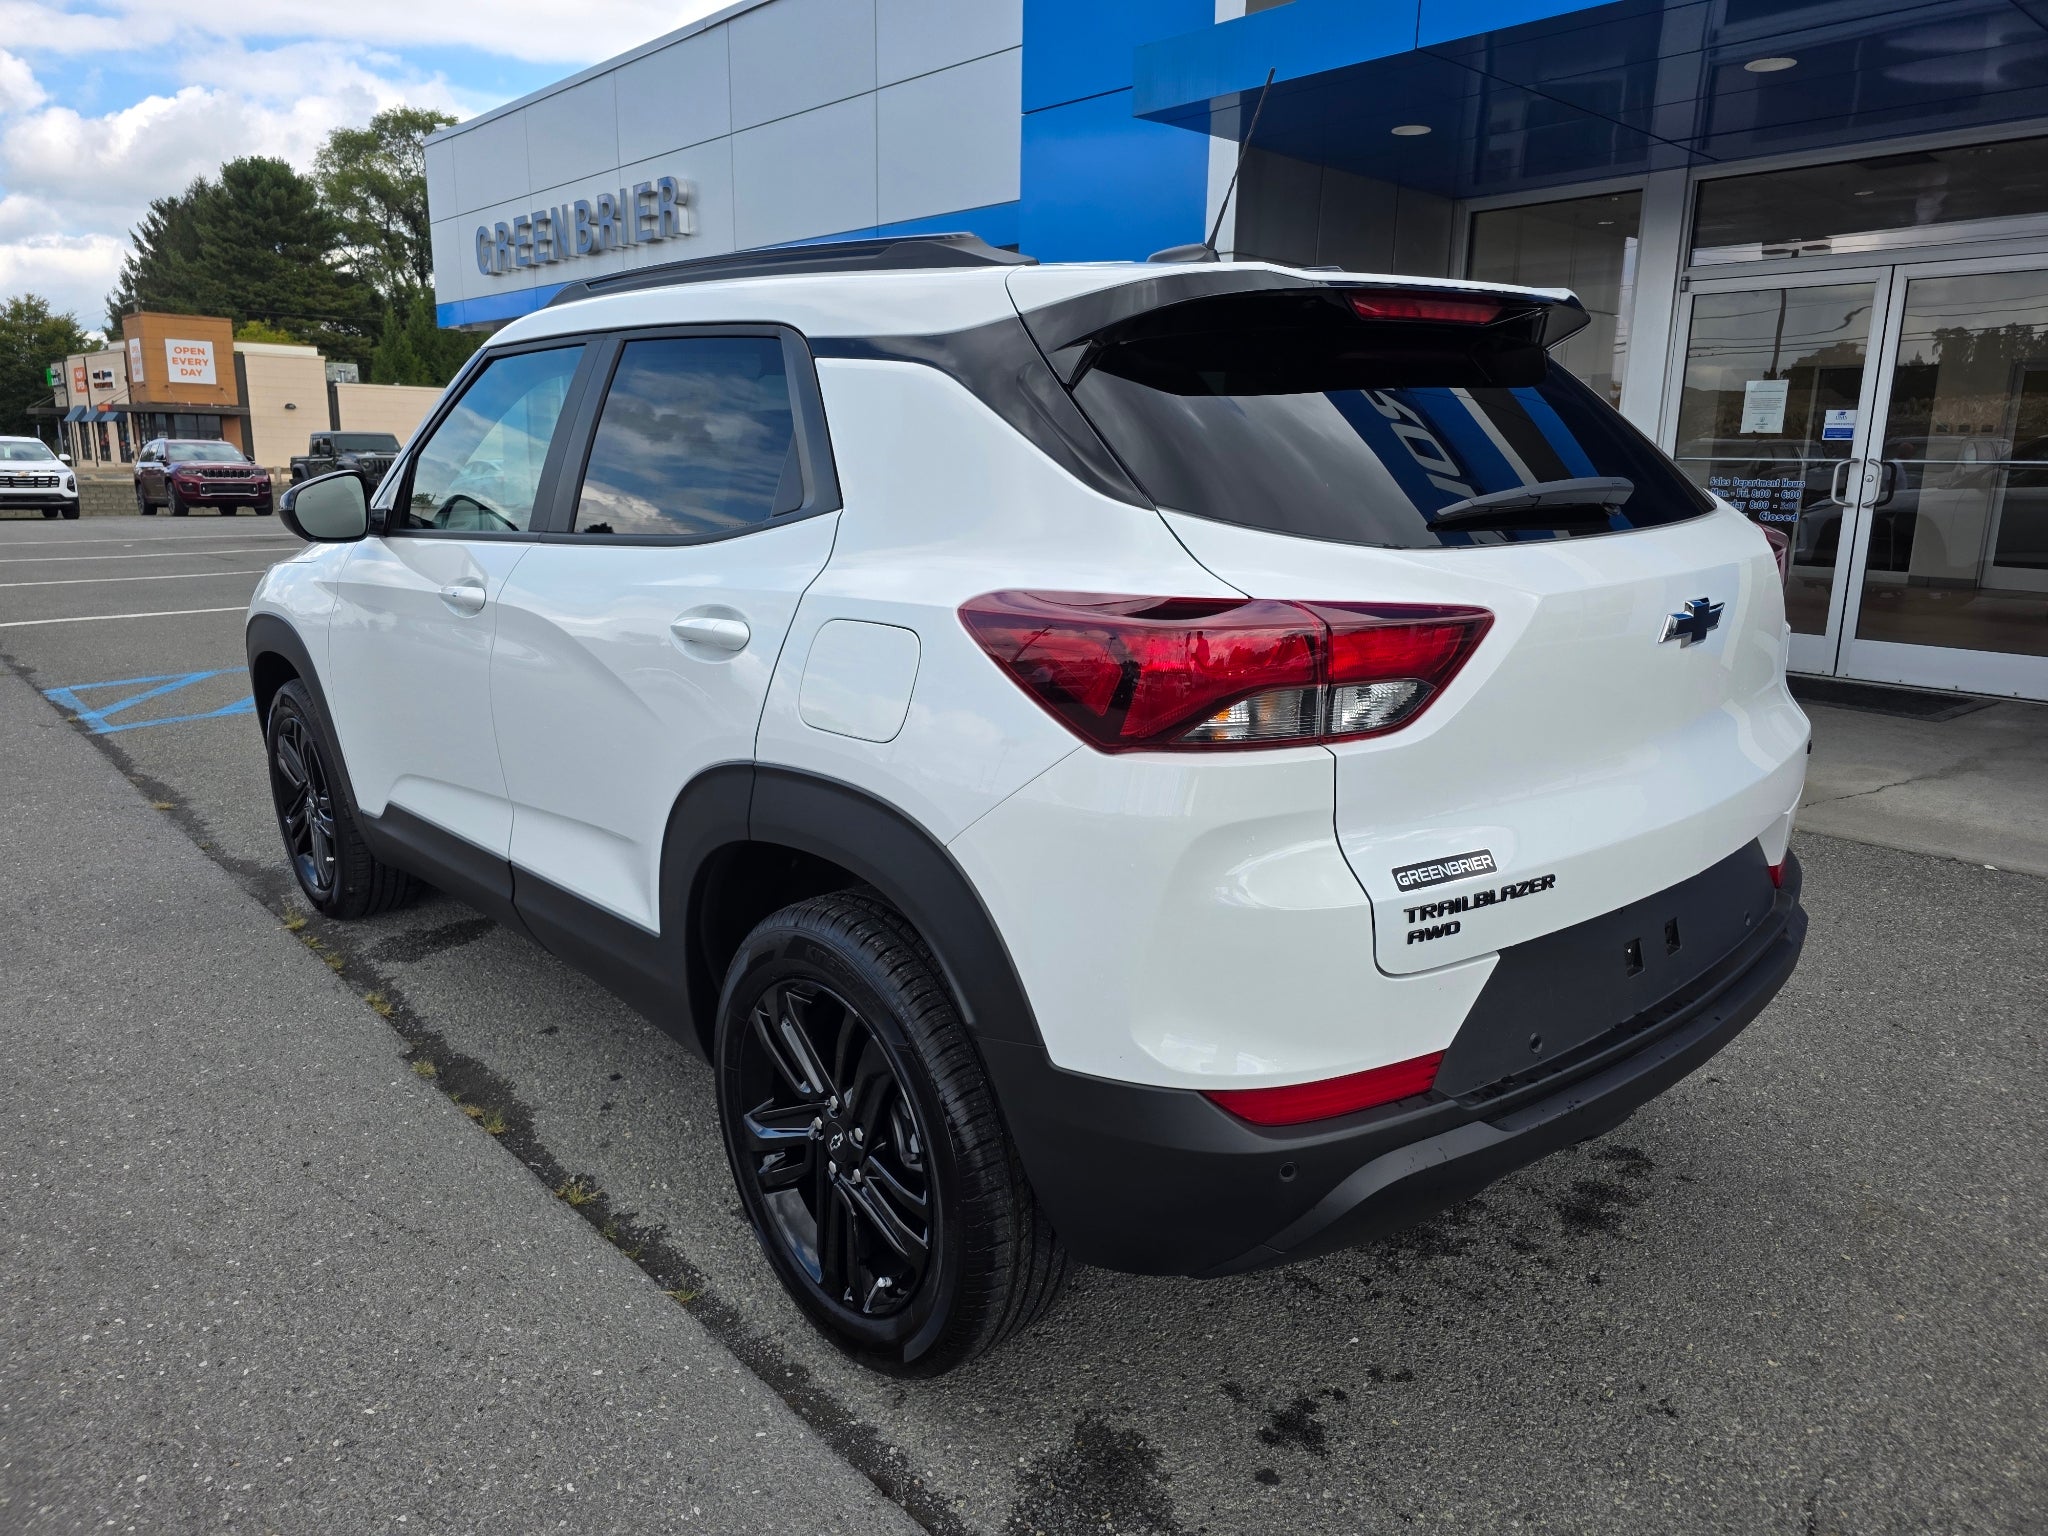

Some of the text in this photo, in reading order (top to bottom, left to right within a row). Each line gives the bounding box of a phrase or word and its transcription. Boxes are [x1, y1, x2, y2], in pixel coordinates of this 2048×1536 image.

[475, 176, 688, 275] GREENBRIER
[174, 346, 206, 355] OPEN
[172, 357, 209, 366] EVERY
[180, 368, 203, 376] DAY
[1709, 476, 1805, 489] Sales Department Hours
[1781, 490, 1801, 499] 6:00
[1759, 511, 1798, 522] Closed
[1396, 854, 1495, 886] GREENBRIER
[1403, 873, 1556, 924] TRAILBLAZER
[1406, 920, 1462, 945] AWD
